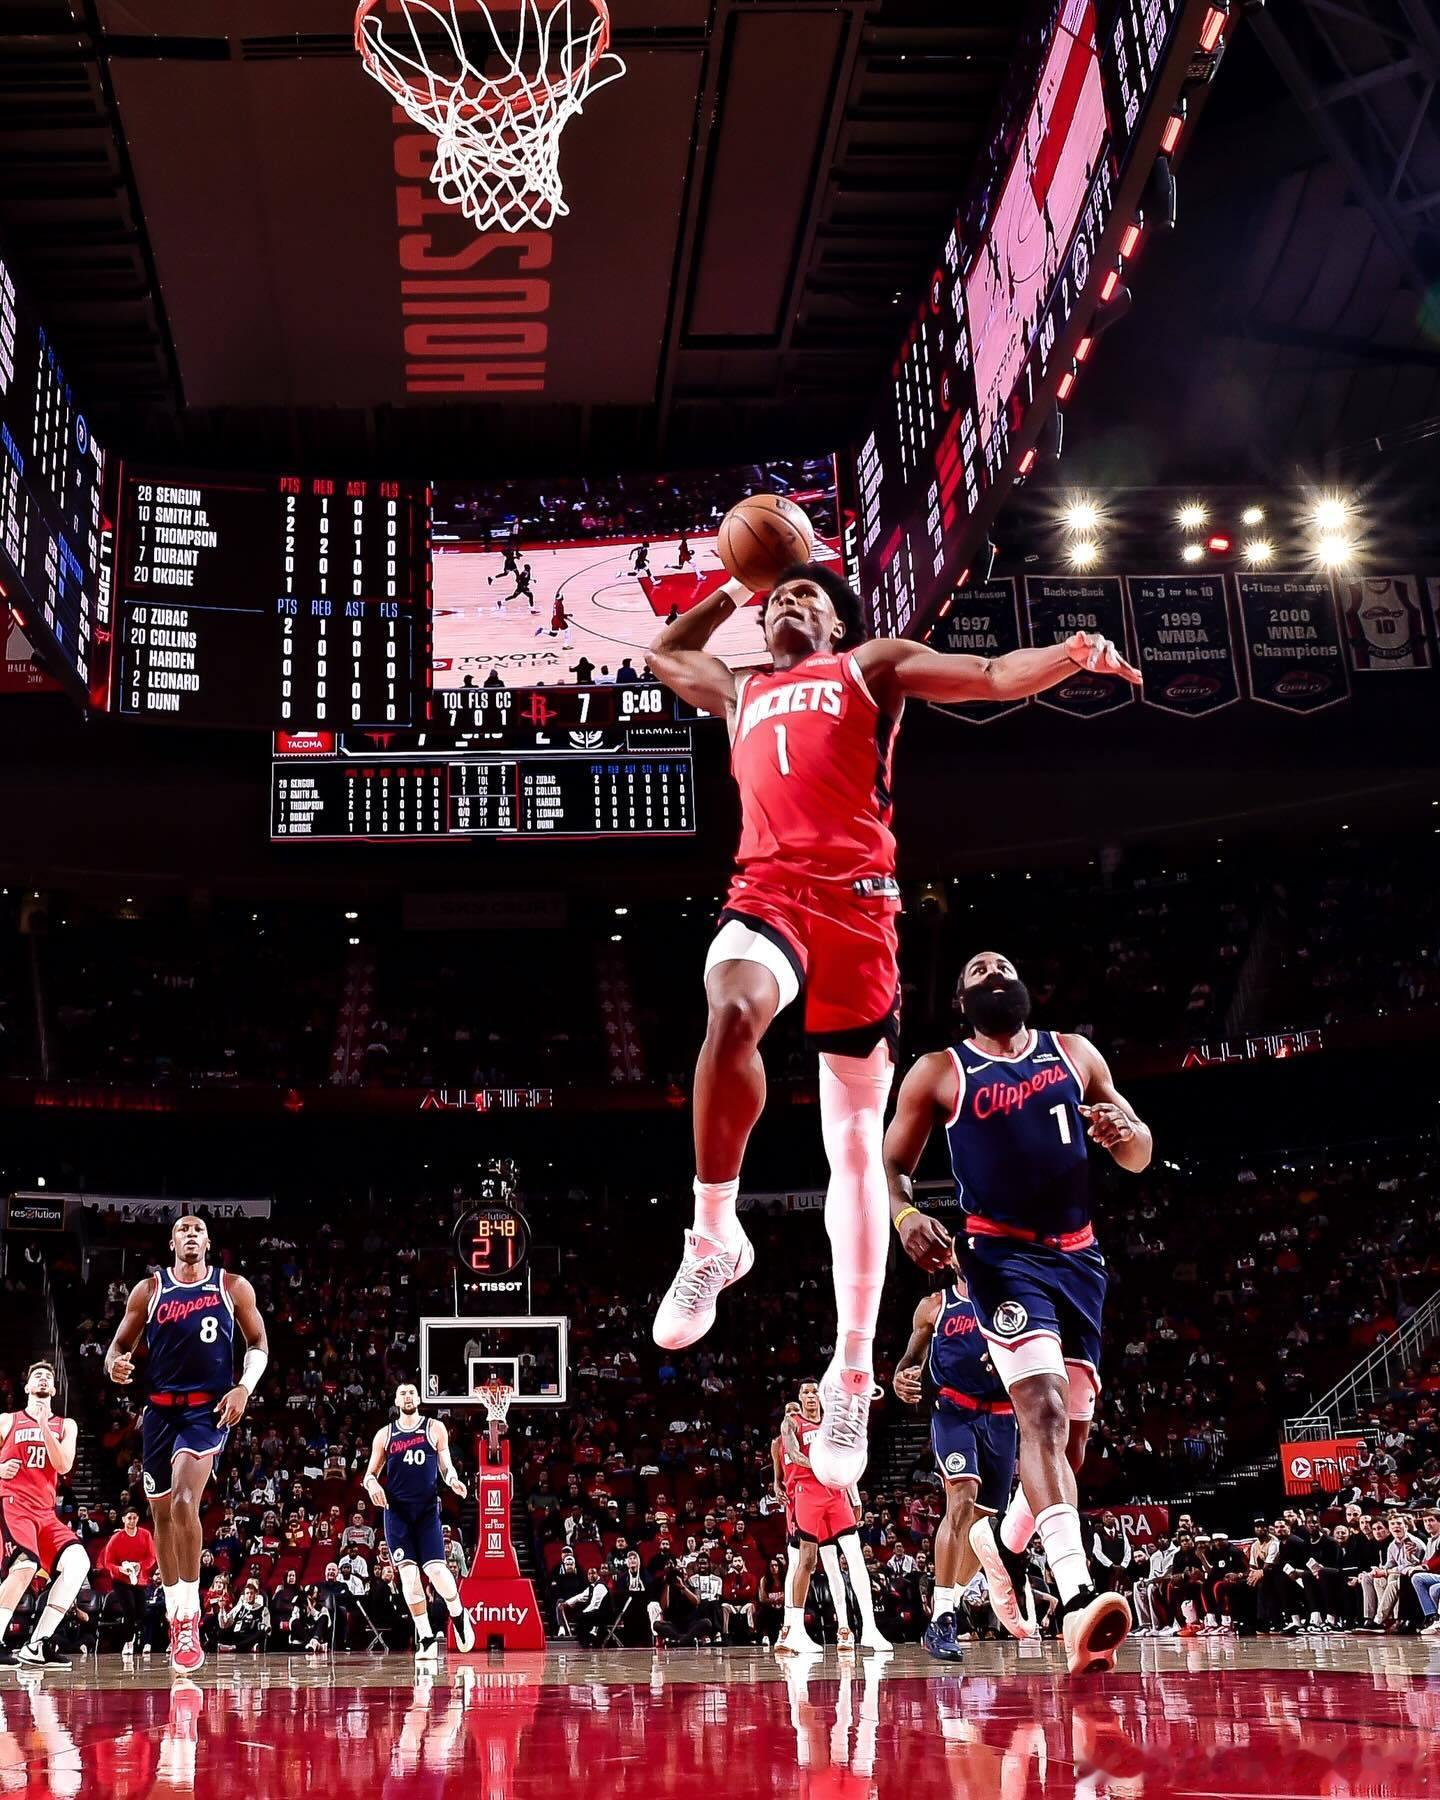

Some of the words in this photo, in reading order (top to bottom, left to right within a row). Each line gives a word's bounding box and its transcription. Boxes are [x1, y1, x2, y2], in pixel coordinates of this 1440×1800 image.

[280, 477, 300, 493] PTS
[314, 480, 333, 494] REB
[347, 482, 365, 496] AST
[381, 483, 398, 497] FLS
[138, 485, 152, 501] 28
[156, 486, 201, 506] SENGUN
[287, 496, 295, 512] 2
[322, 498, 328, 514] 1
[354, 500, 363, 515] 0
[388, 501, 396, 516] 0
[138, 505, 150, 521] 10
[155, 507, 192, 525] SMITH
[193, 510, 210, 527] JR.
[286, 516, 295, 532] 2
[320, 518, 328, 534] 0
[354, 519, 362, 535] 0
[387, 520, 396, 536] 0
[141, 526, 146, 541] 1
[155, 527, 217, 547] THOMPSON
[286, 536, 294, 552] 2
[320, 538, 328, 554] 2
[355, 539, 361, 555] 1
[387, 540, 396, 556] 0
[139, 546, 145, 561] 7
[154, 547, 199, 566] DURANT
[285, 556, 294, 572] 0
[319, 558, 328, 574] 0
[353, 559, 362, 575] 0
[387, 560, 395, 576] 0
[134, 566, 148, 582] 20
[153, 567, 194, 586] OKOGIE
[286, 576, 292, 593] 1
[321, 578, 326, 594] 1
[353, 579, 362, 595] 0
[387, 580, 395, 596] 0
[847, 555, 861, 596] FIR
[96, 562, 112, 624] FIRE
[1043, 586, 1105, 598] Back-to-Back
[1157, 587, 1166, 599] 3
[1241, 583, 1281, 593] 4-Time
[1284, 582, 1330, 594] Champs
[278, 599, 297, 614] PTS
[312, 600, 331, 616] REB
[345, 601, 365, 617] AST
[380, 602, 398, 617] FLS
[1269, 608, 1311, 623] 2000
[132, 607, 146, 623] 40
[150, 608, 188, 627] ZUBAC
[284, 617, 293, 634] 2
[320, 619, 326, 635] 1
[353, 620, 361, 637] 0
[388, 621, 394, 637] 1
[952, 616, 991, 631] 1997
[1160, 612, 1202, 627] 1999
[1375, 619, 1396, 634] 10
[131, 628, 146, 644] 20
[150, 629, 197, 648] COLLINS
[283, 638, 292, 655] 0
[318, 640, 326, 656] 0
[353, 641, 361, 657] 0
[387, 641, 395, 658] 0
[947, 633, 999, 649] WNBA
[1157, 629, 1208, 645] WNBA
[1267, 625, 1319, 641] WNBA
[458, 651, 560, 664] TOYOTA
[1142, 646, 1228, 664] Champions
[1253, 643, 1338, 660] Champions
[7, 663, 28, 673] HALL
[136, 649, 140, 665] 1
[149, 650, 194, 669] HARDEN
[283, 659, 291, 676] 0
[318, 660, 326, 677] 0
[354, 661, 359, 678] 1
[387, 662, 395, 679] 0
[457, 660, 561, 671] CENTER
[133, 670, 140, 686] 2
[148, 671, 199, 691] LEONARD
[282, 680, 291, 697] 0
[317, 681, 326, 698] 0
[352, 682, 361, 699] 0
[388, 683, 394, 699] 1
[132, 691, 139, 708] 8
[147, 692, 180, 711] DUNN
[282, 701, 291, 718] 0
[317, 702, 326, 719] 0
[352, 703, 360, 720] 0
[387, 704, 395, 720] 0
[442, 692, 463, 709] TOL
[468, 692, 488, 709] FLS
[496, 692, 511, 709] CC
[578, 693, 590, 723] 7
[622, 689, 662, 714] 8:48
[449, 710, 457, 726] 7
[474, 710, 483, 726] 0
[501, 709, 506, 725] 1
[287, 740, 323, 749] TACOMA
[774, 724, 789, 776] 1
[974, 1064, 1068, 1120] Clippers
[1049, 1104, 1071, 1145] 1
[479, 1220, 515, 1237] 8:48
[472, 1238, 512, 1269] 21
[479, 1282, 523, 1292] TISSOT
[157, 1294, 220, 1324] Clippers
[200, 1316, 219, 1344] 8
[27, 1445, 46, 1469] 28
[402, 1449, 426, 1465] 40
[465, 1601, 529, 1625] xfinity
